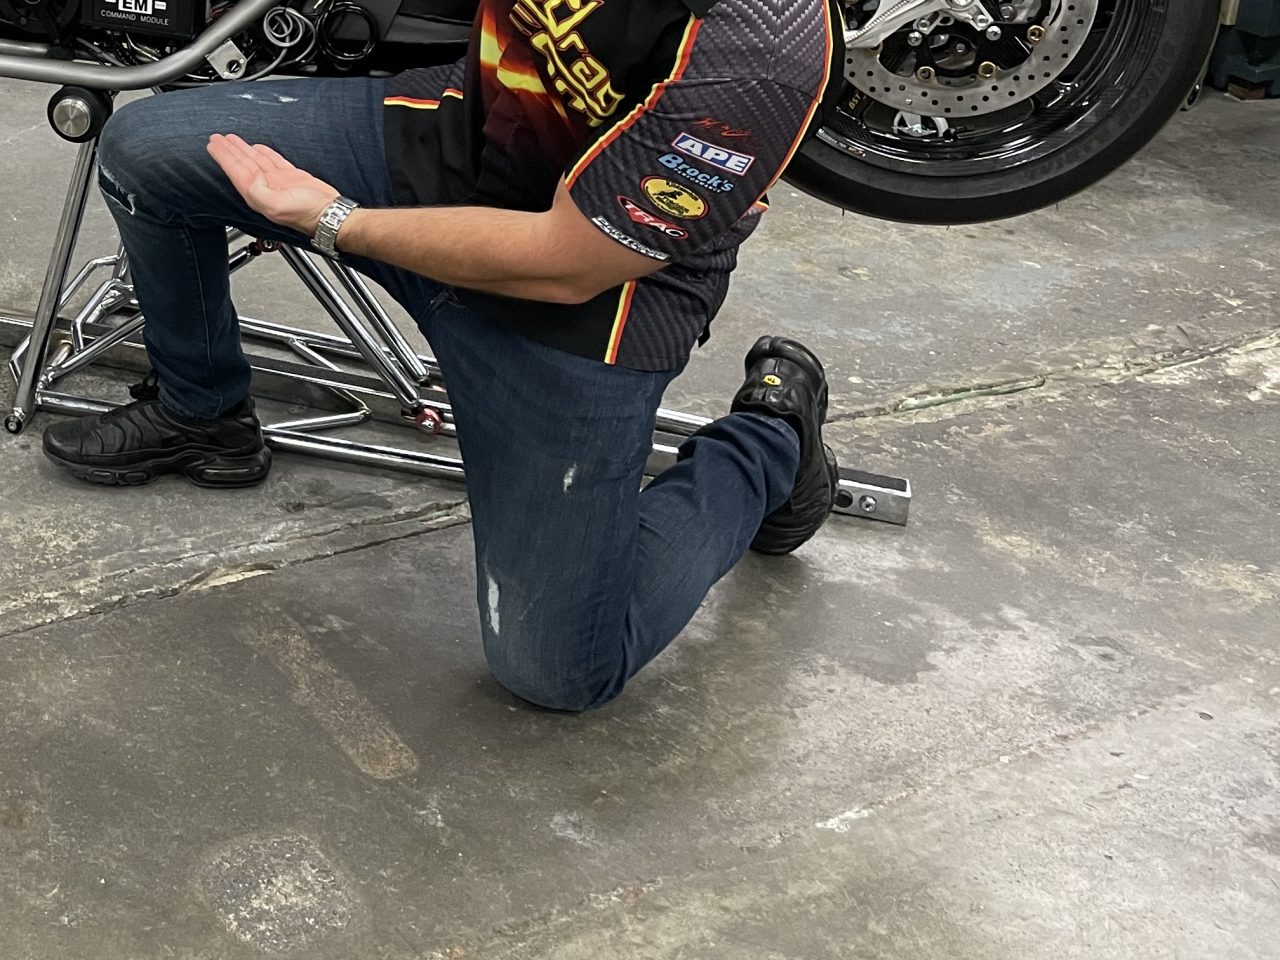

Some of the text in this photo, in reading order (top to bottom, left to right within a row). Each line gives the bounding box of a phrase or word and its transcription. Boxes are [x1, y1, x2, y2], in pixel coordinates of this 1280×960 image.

[101, 10, 169, 25] COMMAND MODULE
[658, 152, 734, 192] Brock's
[677, 139, 750, 172] APE
[623, 200, 685, 237] TRAC
